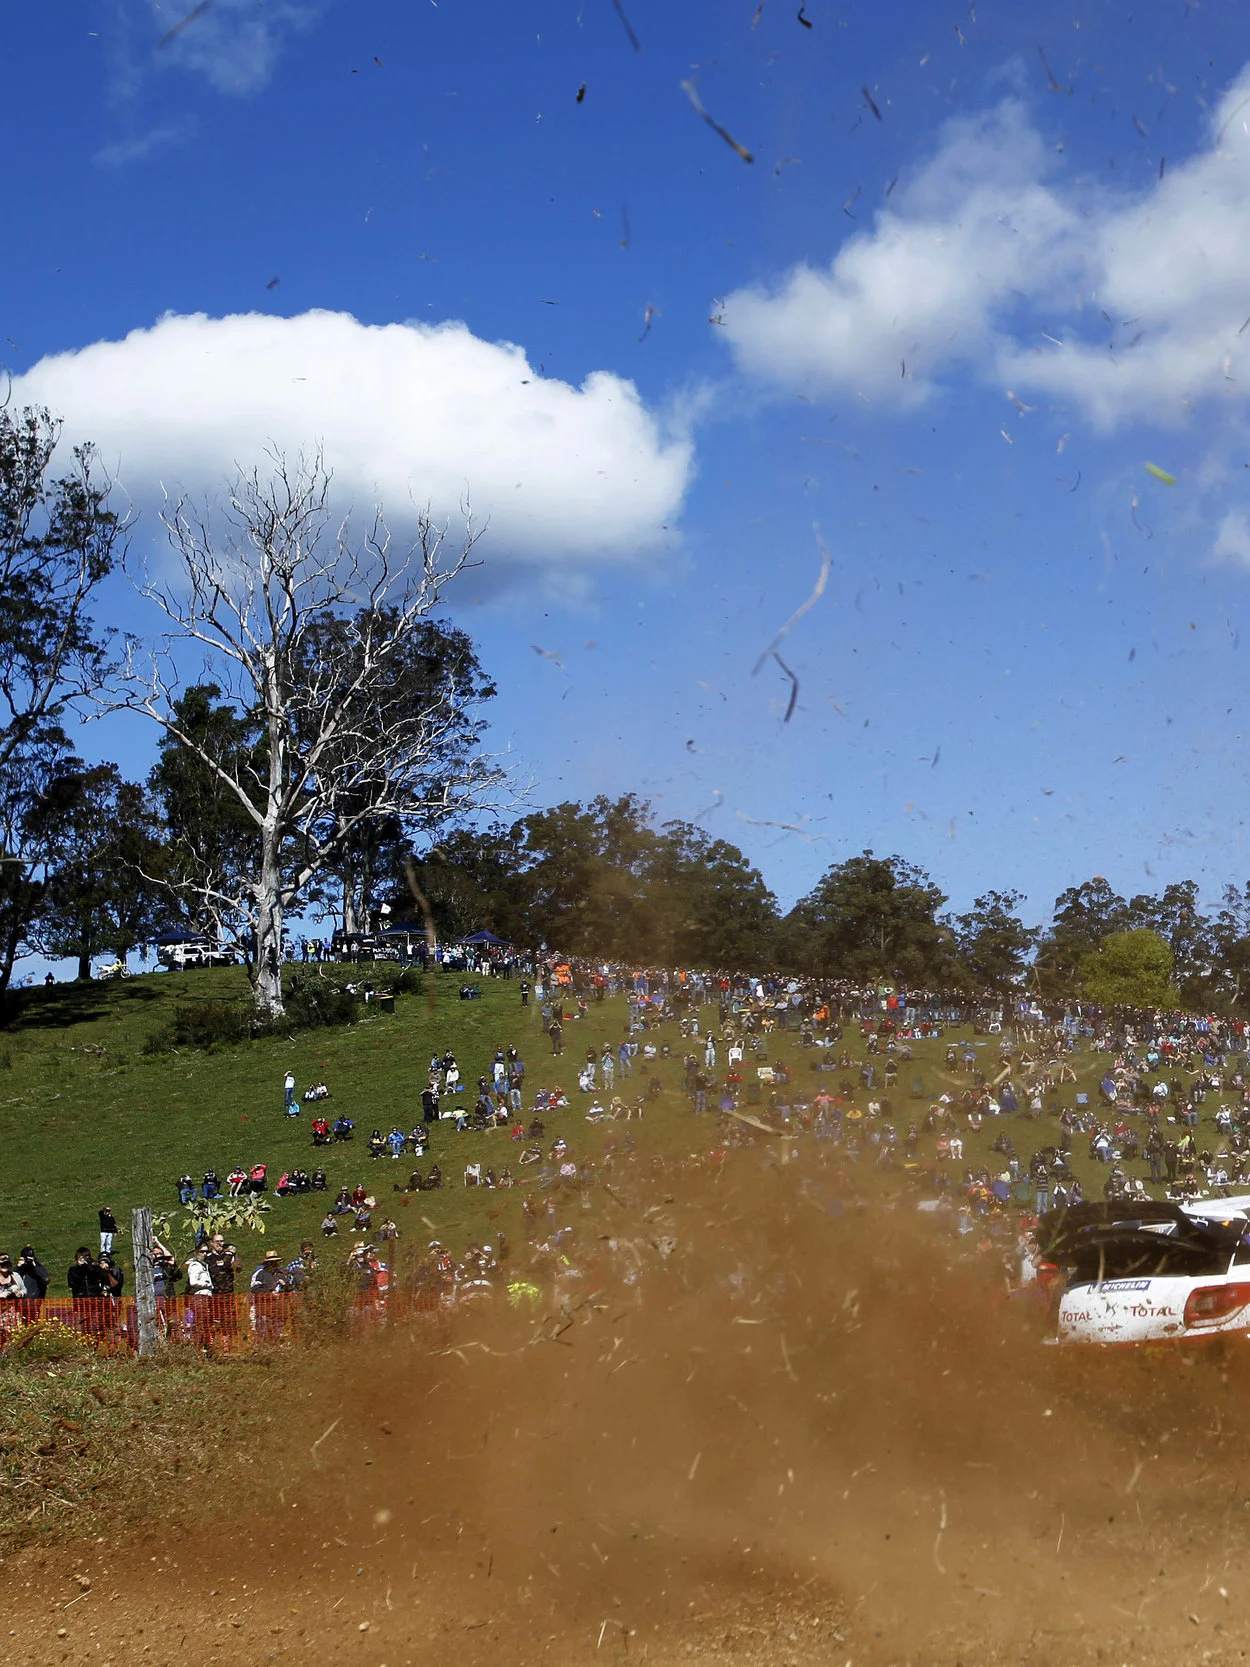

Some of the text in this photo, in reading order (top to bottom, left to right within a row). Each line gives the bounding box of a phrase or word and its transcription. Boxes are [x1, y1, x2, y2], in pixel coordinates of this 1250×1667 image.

[1101, 1281, 1148, 1291] MICHELIN
[1061, 1310, 1093, 1323] TOTAL
[1130, 1304, 1177, 1318] TOTAL
